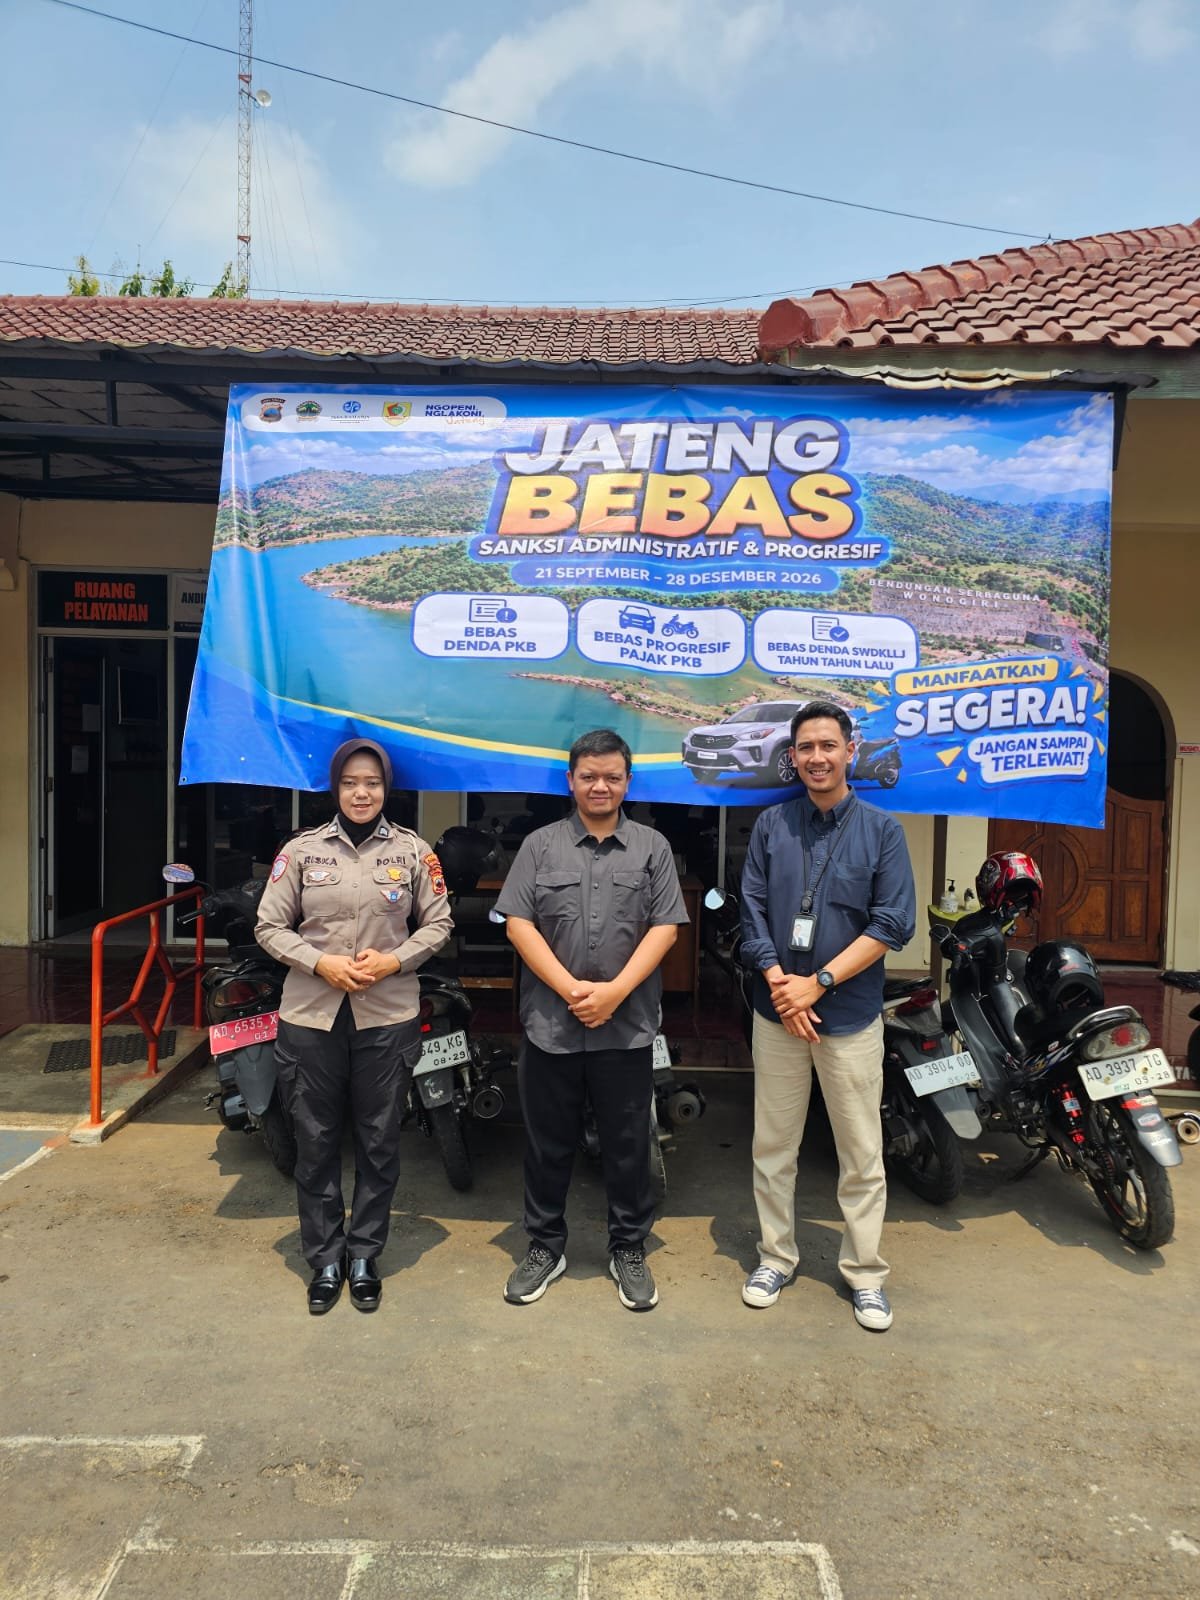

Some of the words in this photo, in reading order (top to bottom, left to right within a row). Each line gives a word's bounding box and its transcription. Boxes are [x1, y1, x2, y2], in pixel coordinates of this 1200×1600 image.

[505, 419, 840, 474] JATENG
[498, 473, 854, 539] BEBAS
[478, 538, 563, 555] SANKSI
[568, 537, 739, 559] ADMINISTRATIF
[743, 540, 760, 556] &
[764, 542, 882, 560] PROGRESIF
[535, 567, 551, 578] 21
[556, 567, 650, 581] SEPTEMBER
[666, 573, 685, 586] 28
[689, 570, 776, 586] DESEMBER
[780, 572, 822, 585] 2026
[74, 581, 136, 599] RUANG
[869, 578, 951, 594] BENDUNGAN
[958, 587, 1040, 602] SERBAGUNA
[903, 591, 999, 608] WONOGIRI
[64, 602, 149, 622] PELAYANAN
[464, 626, 517, 638] BEBAS
[593, 630, 642, 646] BEBAS
[646, 638, 731, 654] PROGRESIF
[444, 639, 500, 652] DENDA
[505, 641, 537, 652] PKB
[767, 642, 806, 653] BEBAS
[809, 644, 849, 656] DENDA
[852, 647, 906, 659] SWDKLLJ
[619, 647, 668, 666] PAJAK
[671, 655, 702, 668] PKB
[777, 655, 819, 666] TAHUN
[821, 657, 861, 669] TAHUN
[864, 660, 894, 671] LALU
[912, 664, 1046, 689] MANFAATKAN
[894, 686, 1088, 738] SEGERA!
[975, 738, 1038, 756] JANGAN
[1040, 736, 1088, 750] SAMPAI
[992, 752, 1084, 772] TERLEWAT!
[304, 856, 338, 866] RISKA
[213, 1025, 228, 1039] AD
[908, 1068, 923, 1082] AD
[1085, 1066, 1102, 1081] AD
[1106, 1058, 1136, 1077] 3937
